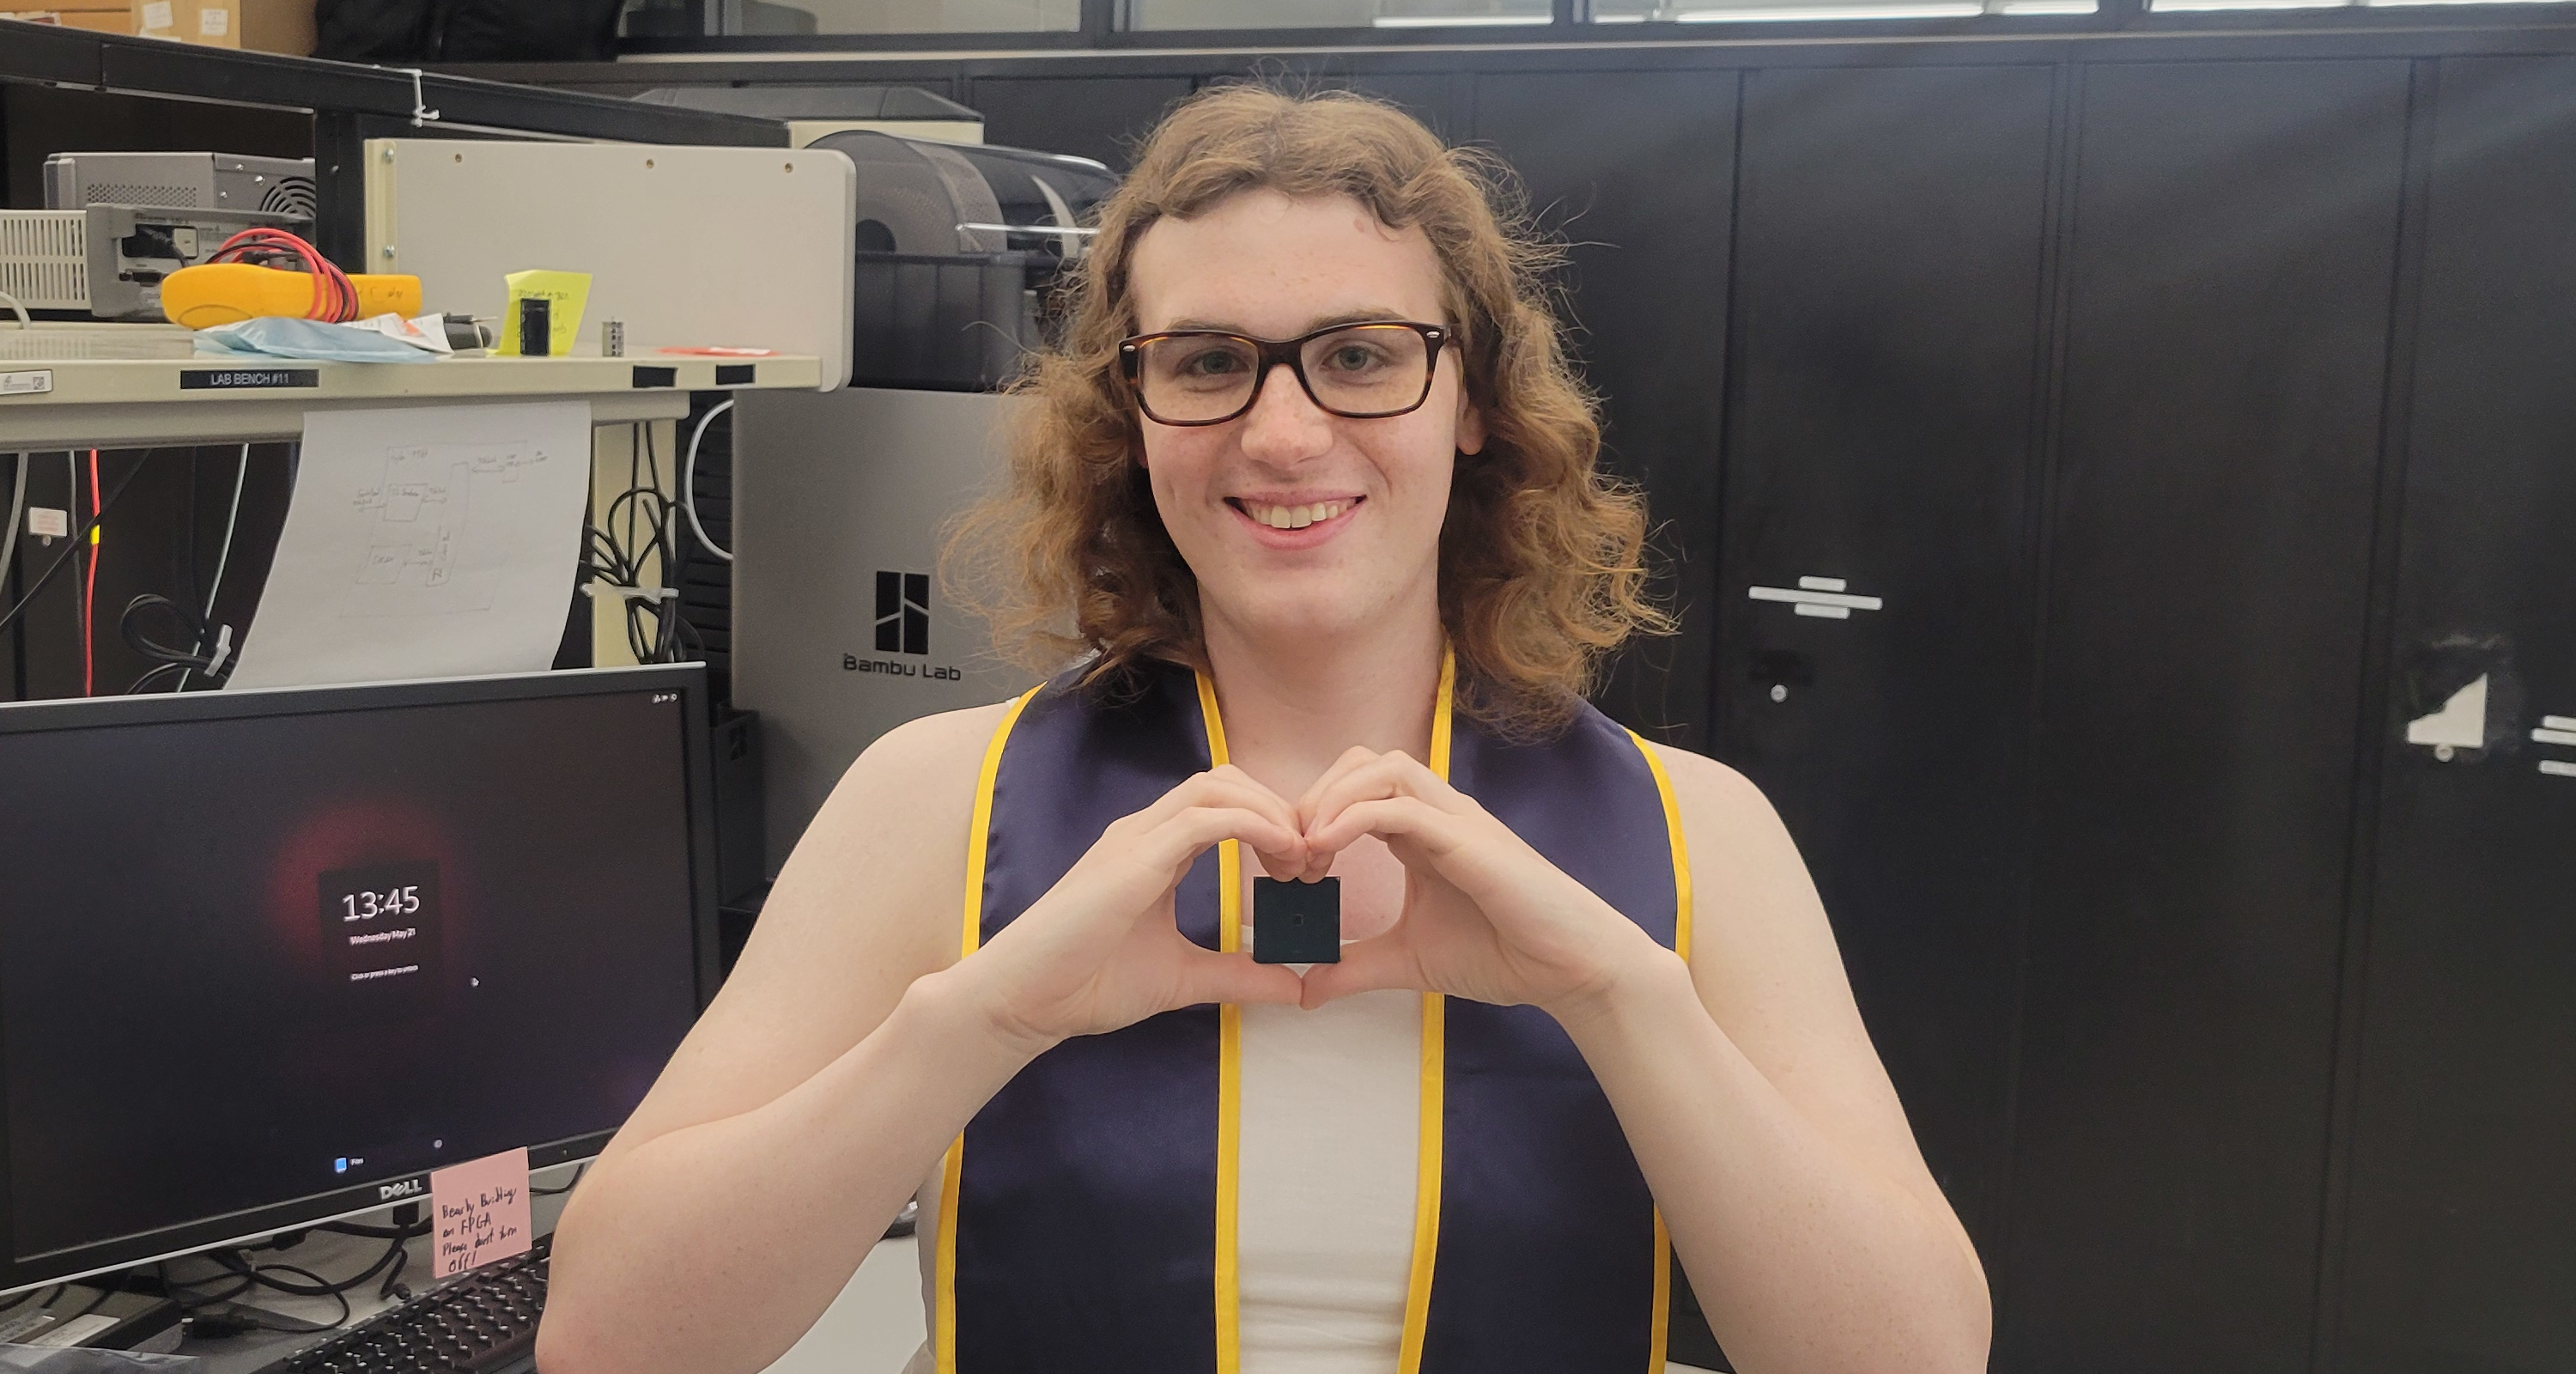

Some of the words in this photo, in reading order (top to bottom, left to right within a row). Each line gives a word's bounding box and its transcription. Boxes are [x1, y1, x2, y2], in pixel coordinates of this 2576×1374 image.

[210, 374, 232, 386] LAB
[234, 374, 270, 385] BENCH
[271, 373, 289, 384] #11
[843, 654, 915, 677] Bambu
[923, 663, 961, 681] Lab
[343, 885, 419, 921] 13:45
[380, 1179, 422, 1200] DELL
[460, 1212, 492, 1236] FPGA
